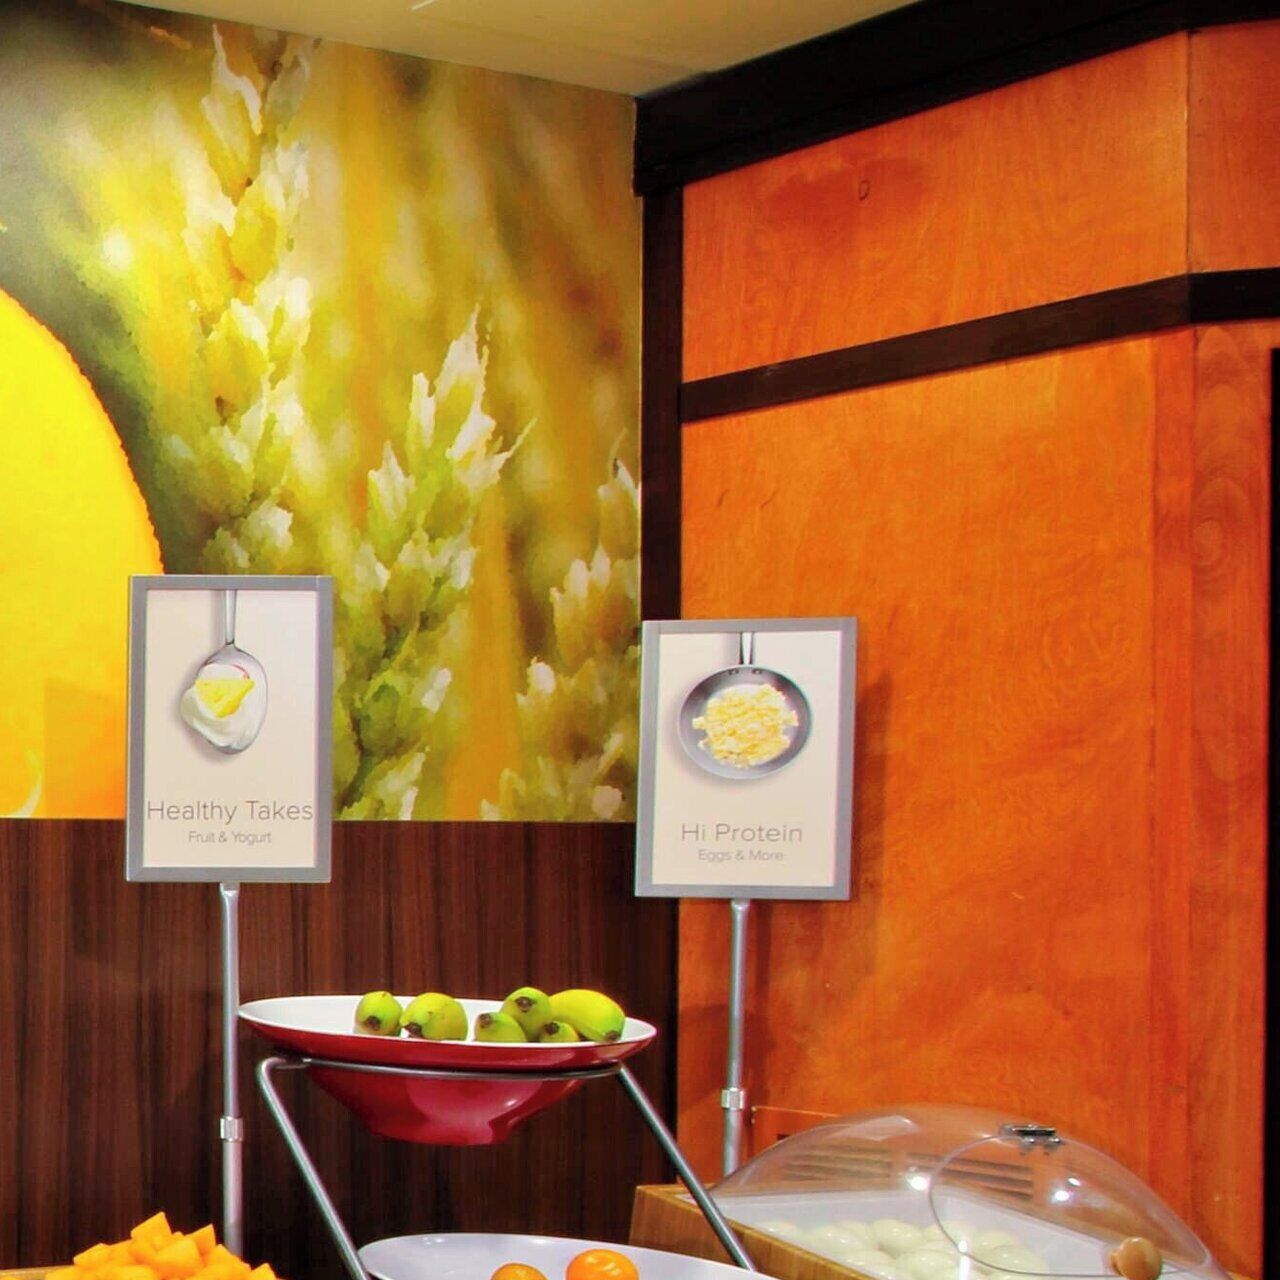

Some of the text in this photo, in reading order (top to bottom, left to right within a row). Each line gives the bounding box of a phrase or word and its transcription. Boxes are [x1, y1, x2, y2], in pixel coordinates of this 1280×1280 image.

[147, 800, 313, 825] Healthy Takes
[188, 831, 272, 846] Fruit & Yogurt
[681, 823, 803, 843] Hi Protein
[698, 850, 784, 863] Eggs & More
